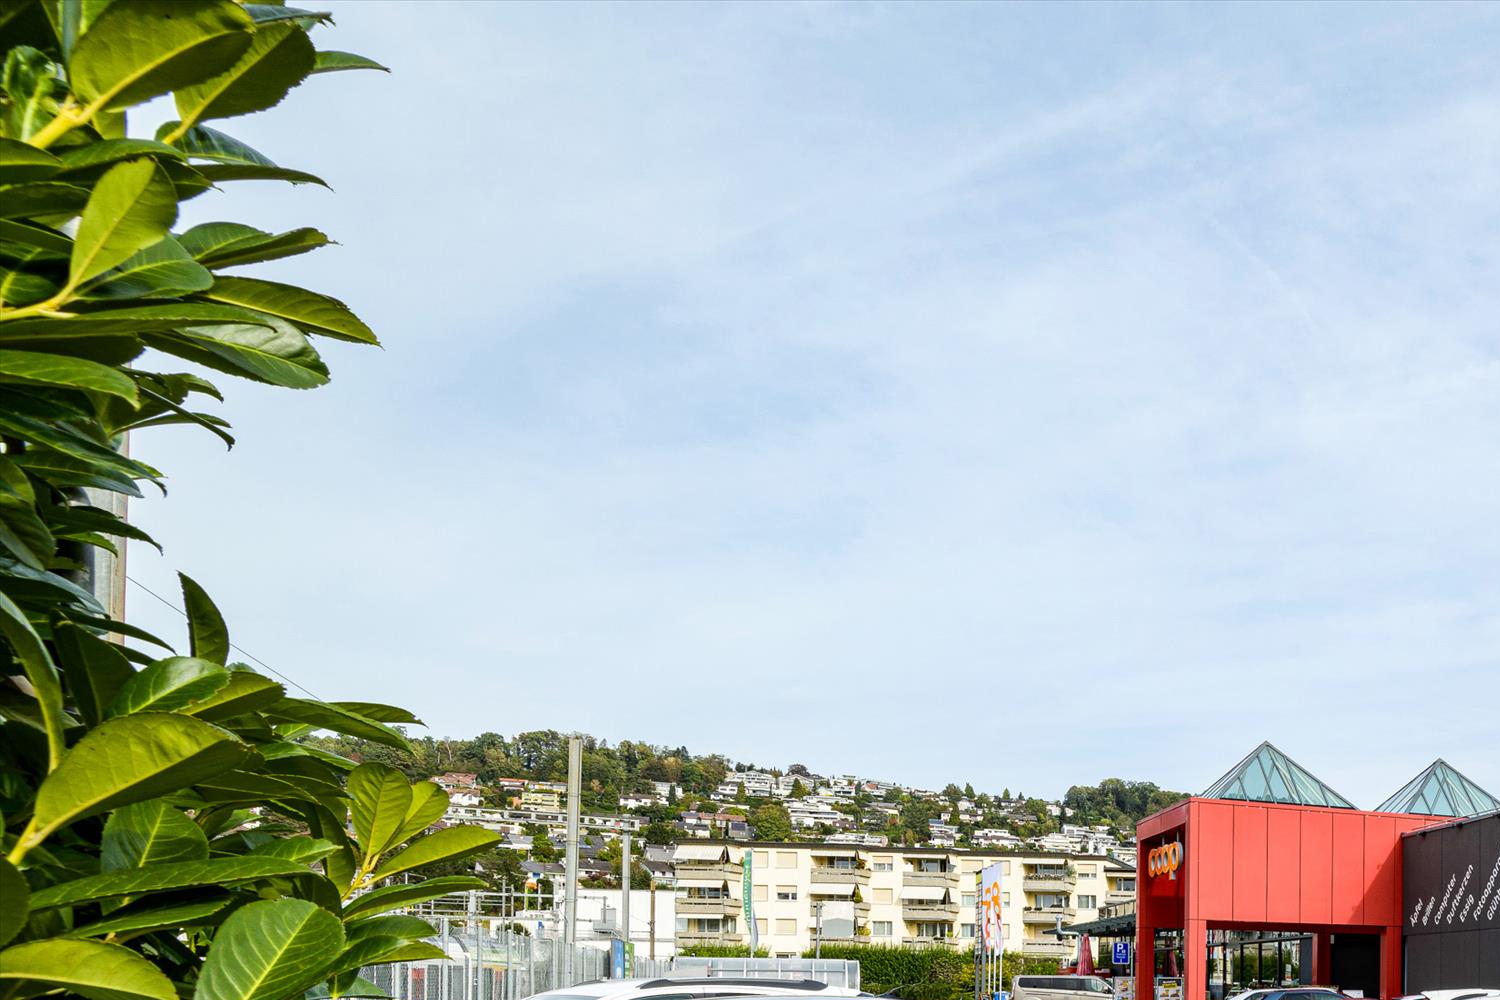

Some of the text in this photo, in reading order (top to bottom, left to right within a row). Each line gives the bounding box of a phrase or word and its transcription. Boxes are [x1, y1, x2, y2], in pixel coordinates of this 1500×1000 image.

[1148, 841, 1183, 880] coop
[1422, 896, 1436, 926] Brillen
[1434, 874, 1457, 925] Computer
[1446, 864, 1474, 924] Duftkerzen
[1459, 894, 1475, 923] Essig
[1117, 943, 1123, 952] P
